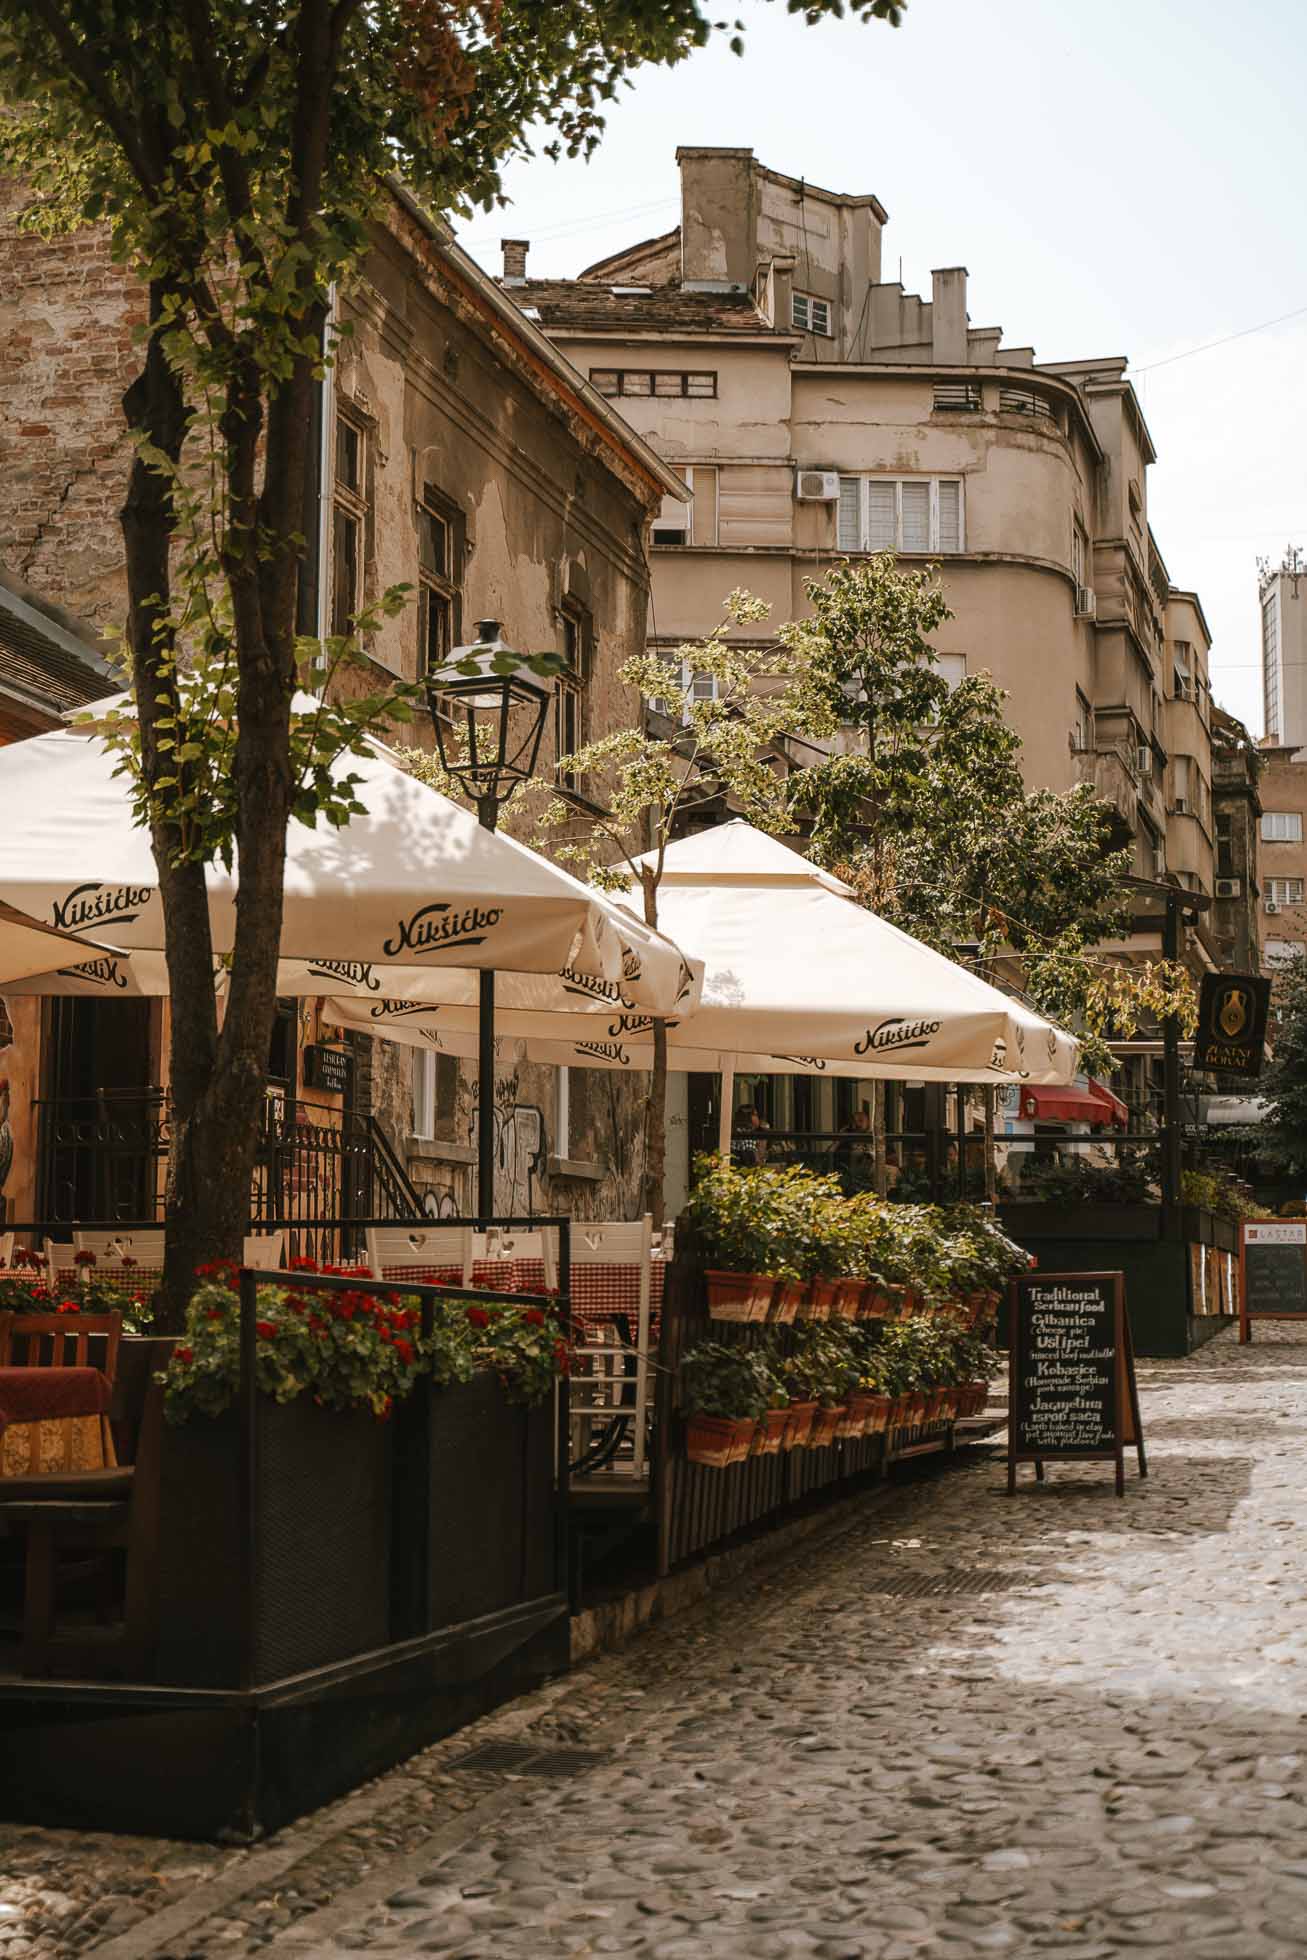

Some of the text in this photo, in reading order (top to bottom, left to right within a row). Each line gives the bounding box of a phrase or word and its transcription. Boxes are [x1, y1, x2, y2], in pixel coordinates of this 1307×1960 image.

[46, 882, 153, 930] Nikšićko
[383, 903, 501, 956] Nikšićko
[854, 1017, 940, 1055] Nikšićko
[1028, 1287, 1100, 1301] Traditional
[1034, 1300, 1105, 1313] Serbian food
[1031, 1314, 1096, 1327] Gibanica
[1037, 1361, 1097, 1376] Kobasice
